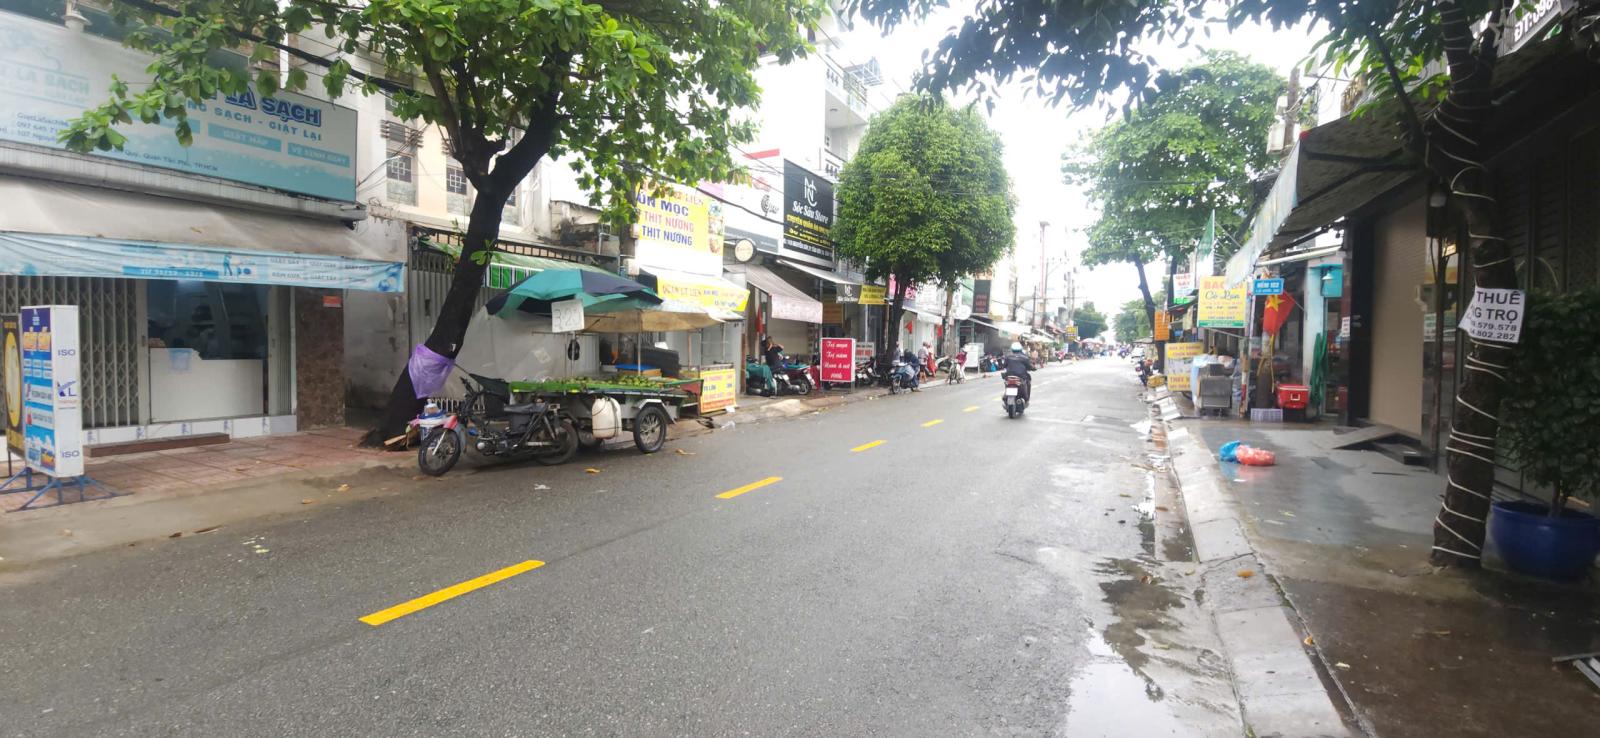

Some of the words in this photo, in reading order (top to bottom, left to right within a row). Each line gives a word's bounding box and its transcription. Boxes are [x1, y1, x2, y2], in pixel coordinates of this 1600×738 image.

[261, 96, 322, 127] SẠCH
[660, 200, 689, 217] MỌC
[814, 208, 830, 225] Store
[1476, 290, 1521, 305] THUÊ
[1486, 308, 1518, 324] TRỌ
[61, 450, 80, 458] ISO
